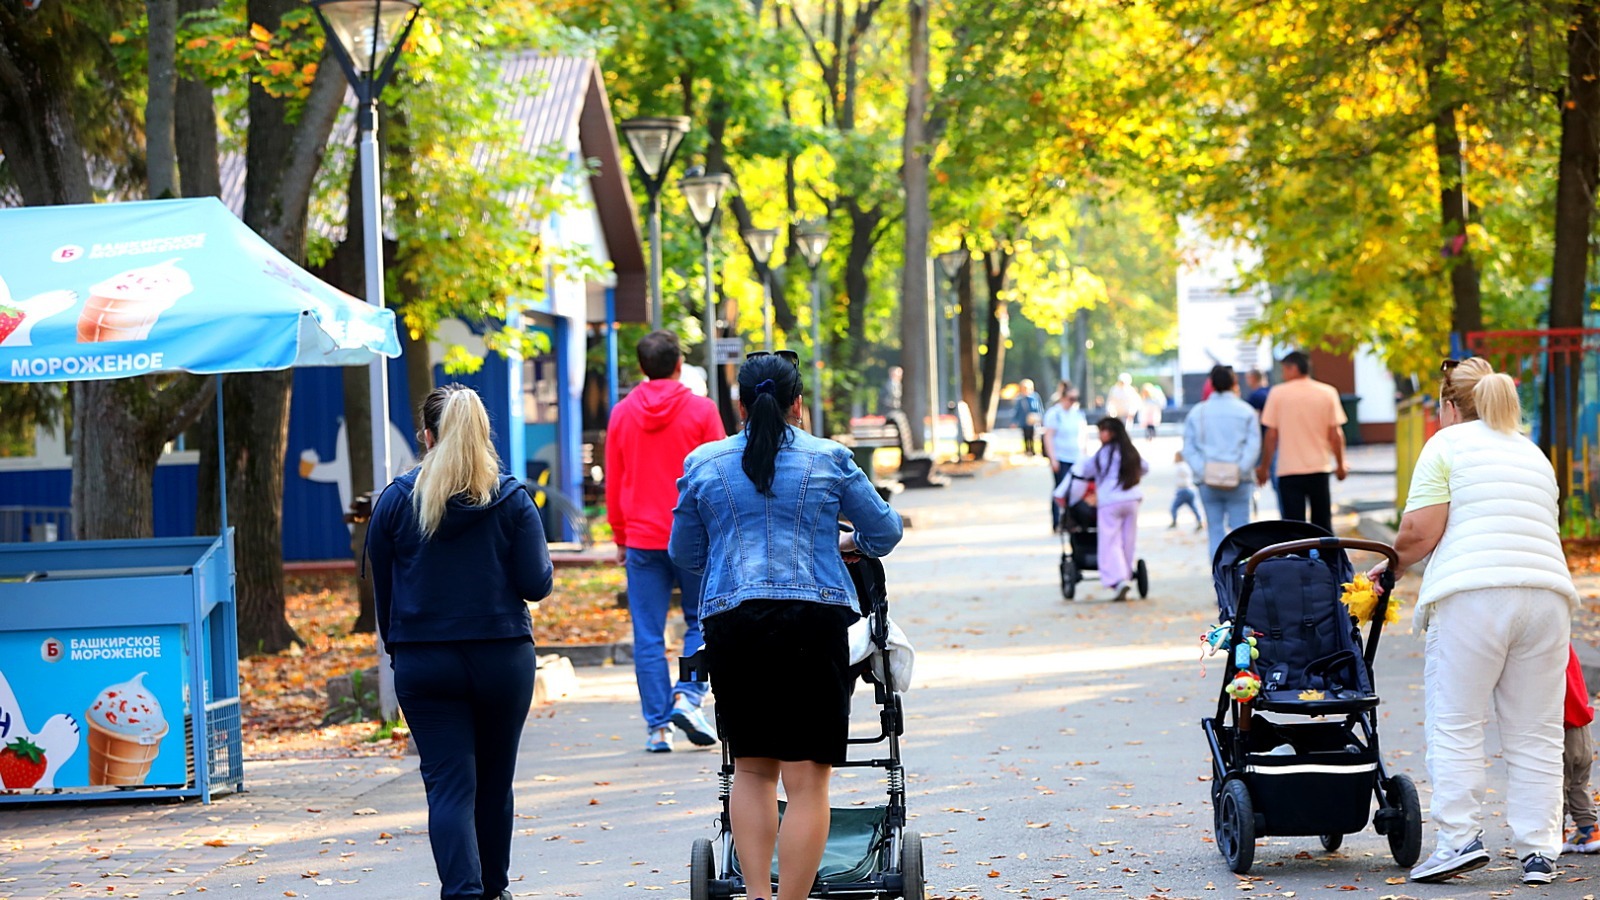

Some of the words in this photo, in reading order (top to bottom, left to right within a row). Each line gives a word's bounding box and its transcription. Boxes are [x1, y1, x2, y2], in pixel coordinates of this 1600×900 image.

[11, 352, 164, 377] МОРОЖЕНОЕ
[70, 636, 161, 649] БАШКИРСКОЕ
[47, 643, 59, 657] Б
[70, 647, 161, 661] МОРОЖЕНОЕ
